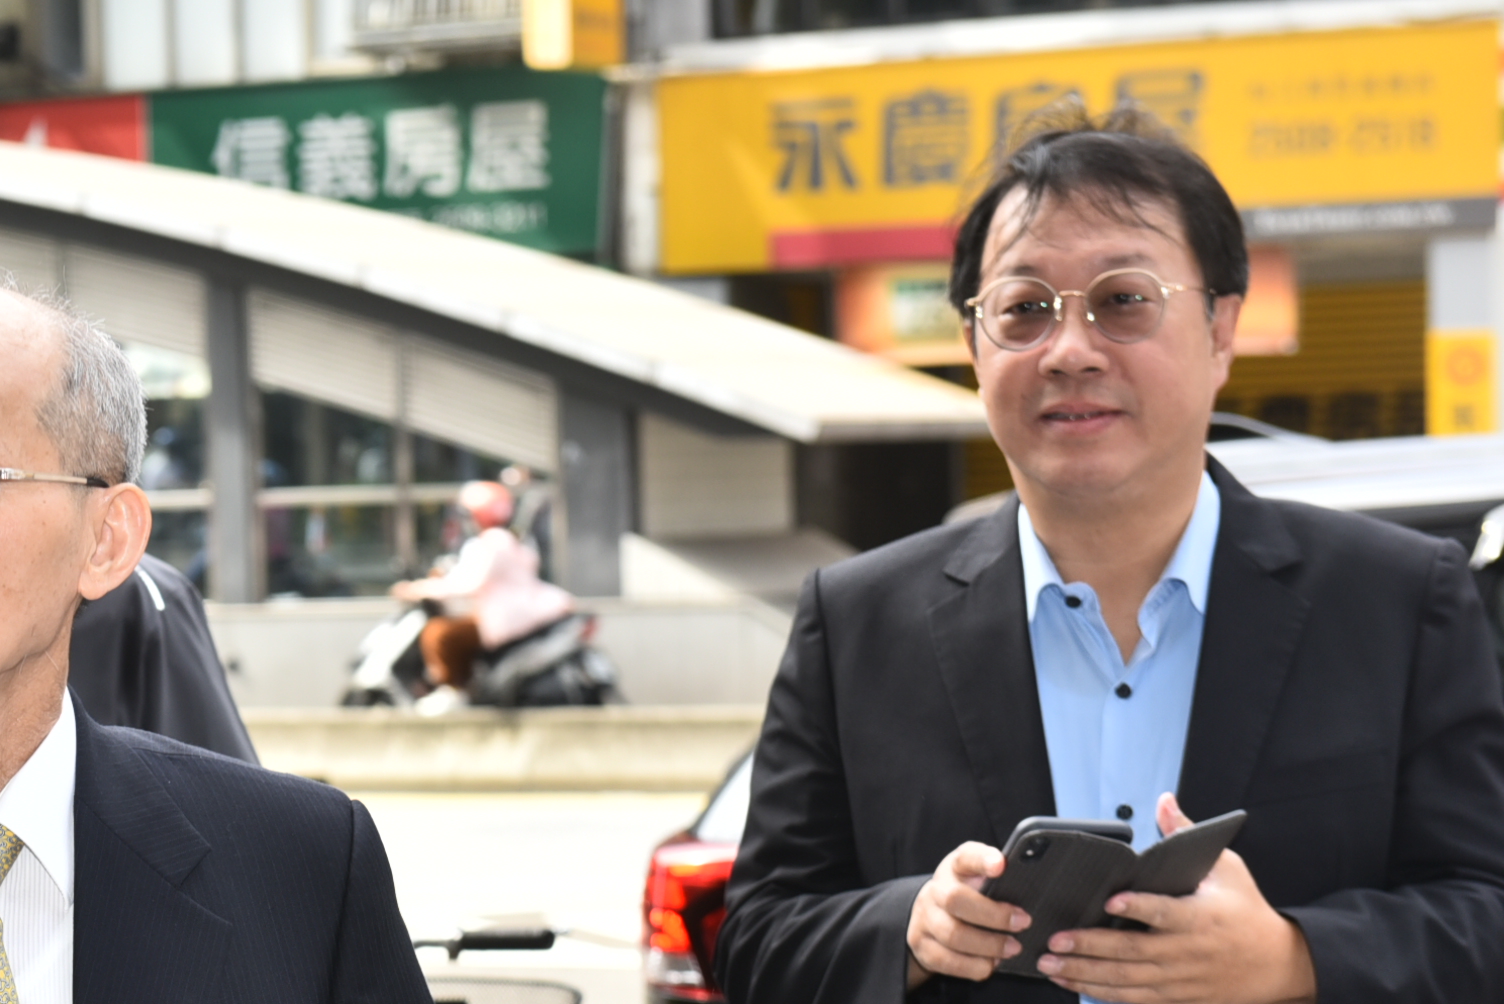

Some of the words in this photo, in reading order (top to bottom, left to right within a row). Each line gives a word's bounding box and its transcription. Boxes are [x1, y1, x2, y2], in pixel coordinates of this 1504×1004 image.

[212, 100, 551, 201] 信義房屋
[769, 68, 1205, 191] 永慶
